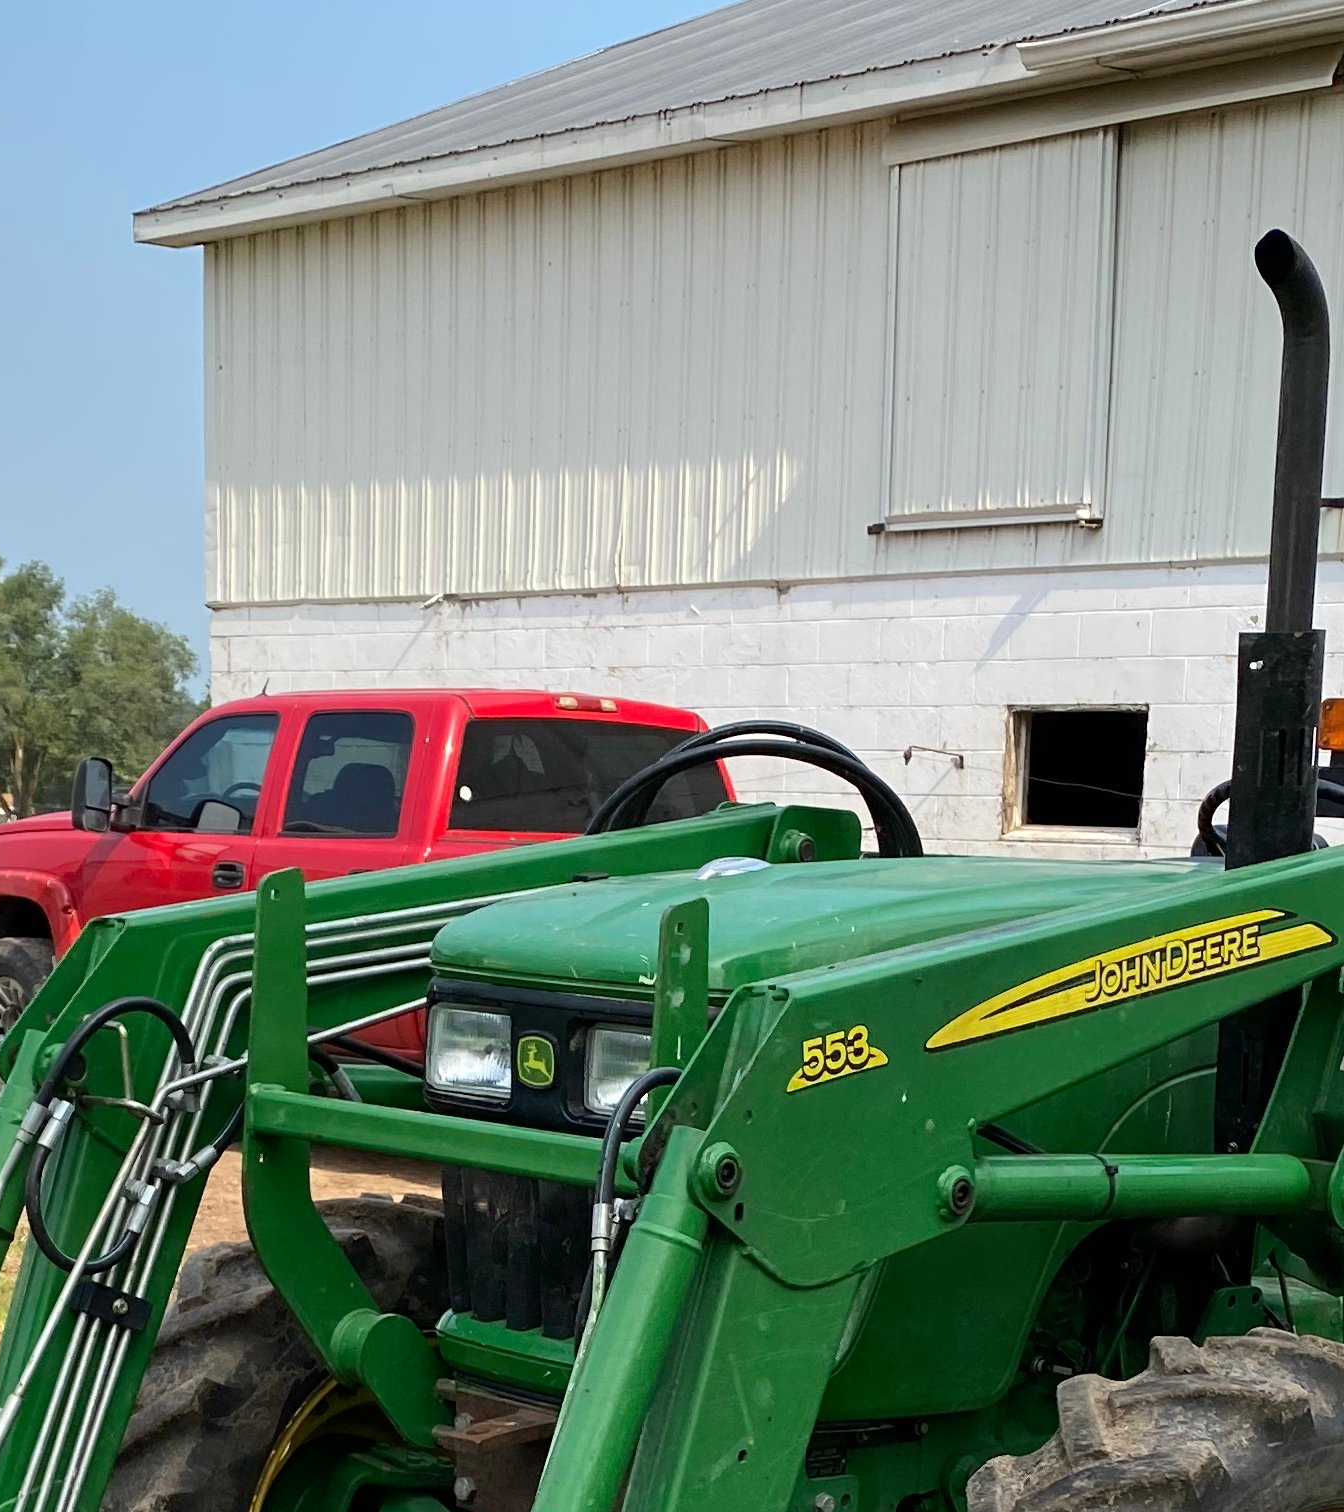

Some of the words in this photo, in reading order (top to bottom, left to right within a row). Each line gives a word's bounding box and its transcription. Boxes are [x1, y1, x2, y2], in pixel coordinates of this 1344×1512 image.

[1085, 951, 1162, 1002] JOHN
[1165, 924, 1260, 981] DEERE
[802, 1024, 870, 1081] 553
